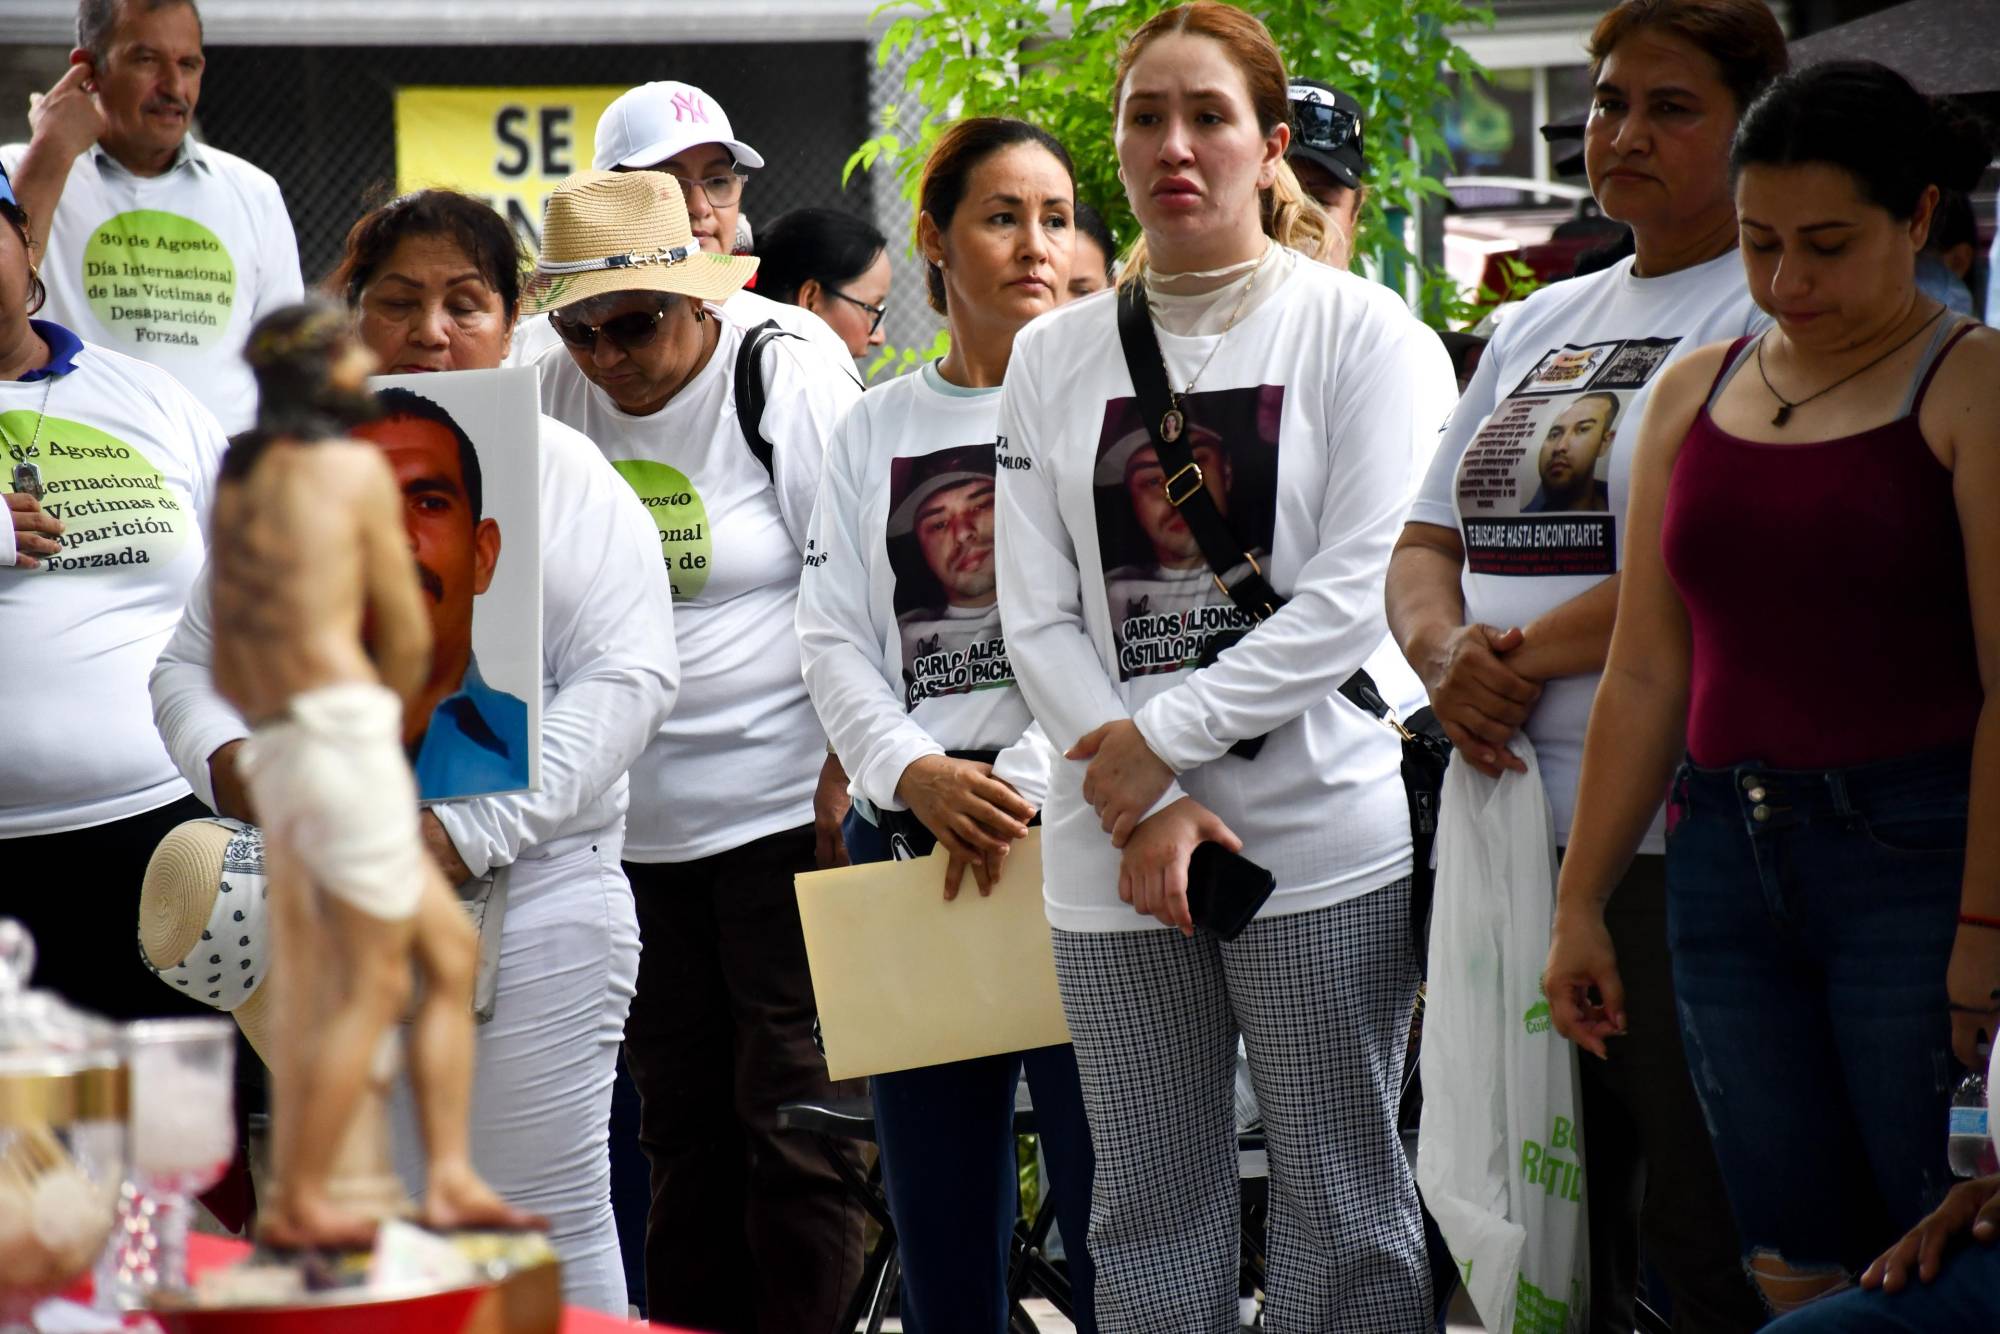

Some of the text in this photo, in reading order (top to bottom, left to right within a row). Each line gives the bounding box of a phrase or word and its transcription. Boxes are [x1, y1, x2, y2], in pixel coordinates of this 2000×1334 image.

[495, 106, 572, 177] SE
[100, 233, 219, 254] 30 de Agosto
[87, 261, 232, 284] Día Internacional
[88, 283, 232, 307] de las Víctimas de
[111, 306, 217, 326] Desaparición
[135, 328, 199, 346] Forzada
[9, 441, 130, 461] de Agosto
[997, 453, 1032, 470] ARLOS
[43, 497, 180, 520] Víctimas de
[53, 517, 174, 549] aparición
[1468, 523, 1603, 547] TE BUSCARE HASTA ENCONTRARTE
[45, 547, 150, 572] Forzada
[680, 552, 707, 570] de
[1122, 613, 1183, 643] CARLOS
[914, 651, 965, 680] CARLO
[1121, 638, 1185, 671] CASTILLO
[970, 659, 1016, 684] PACH
